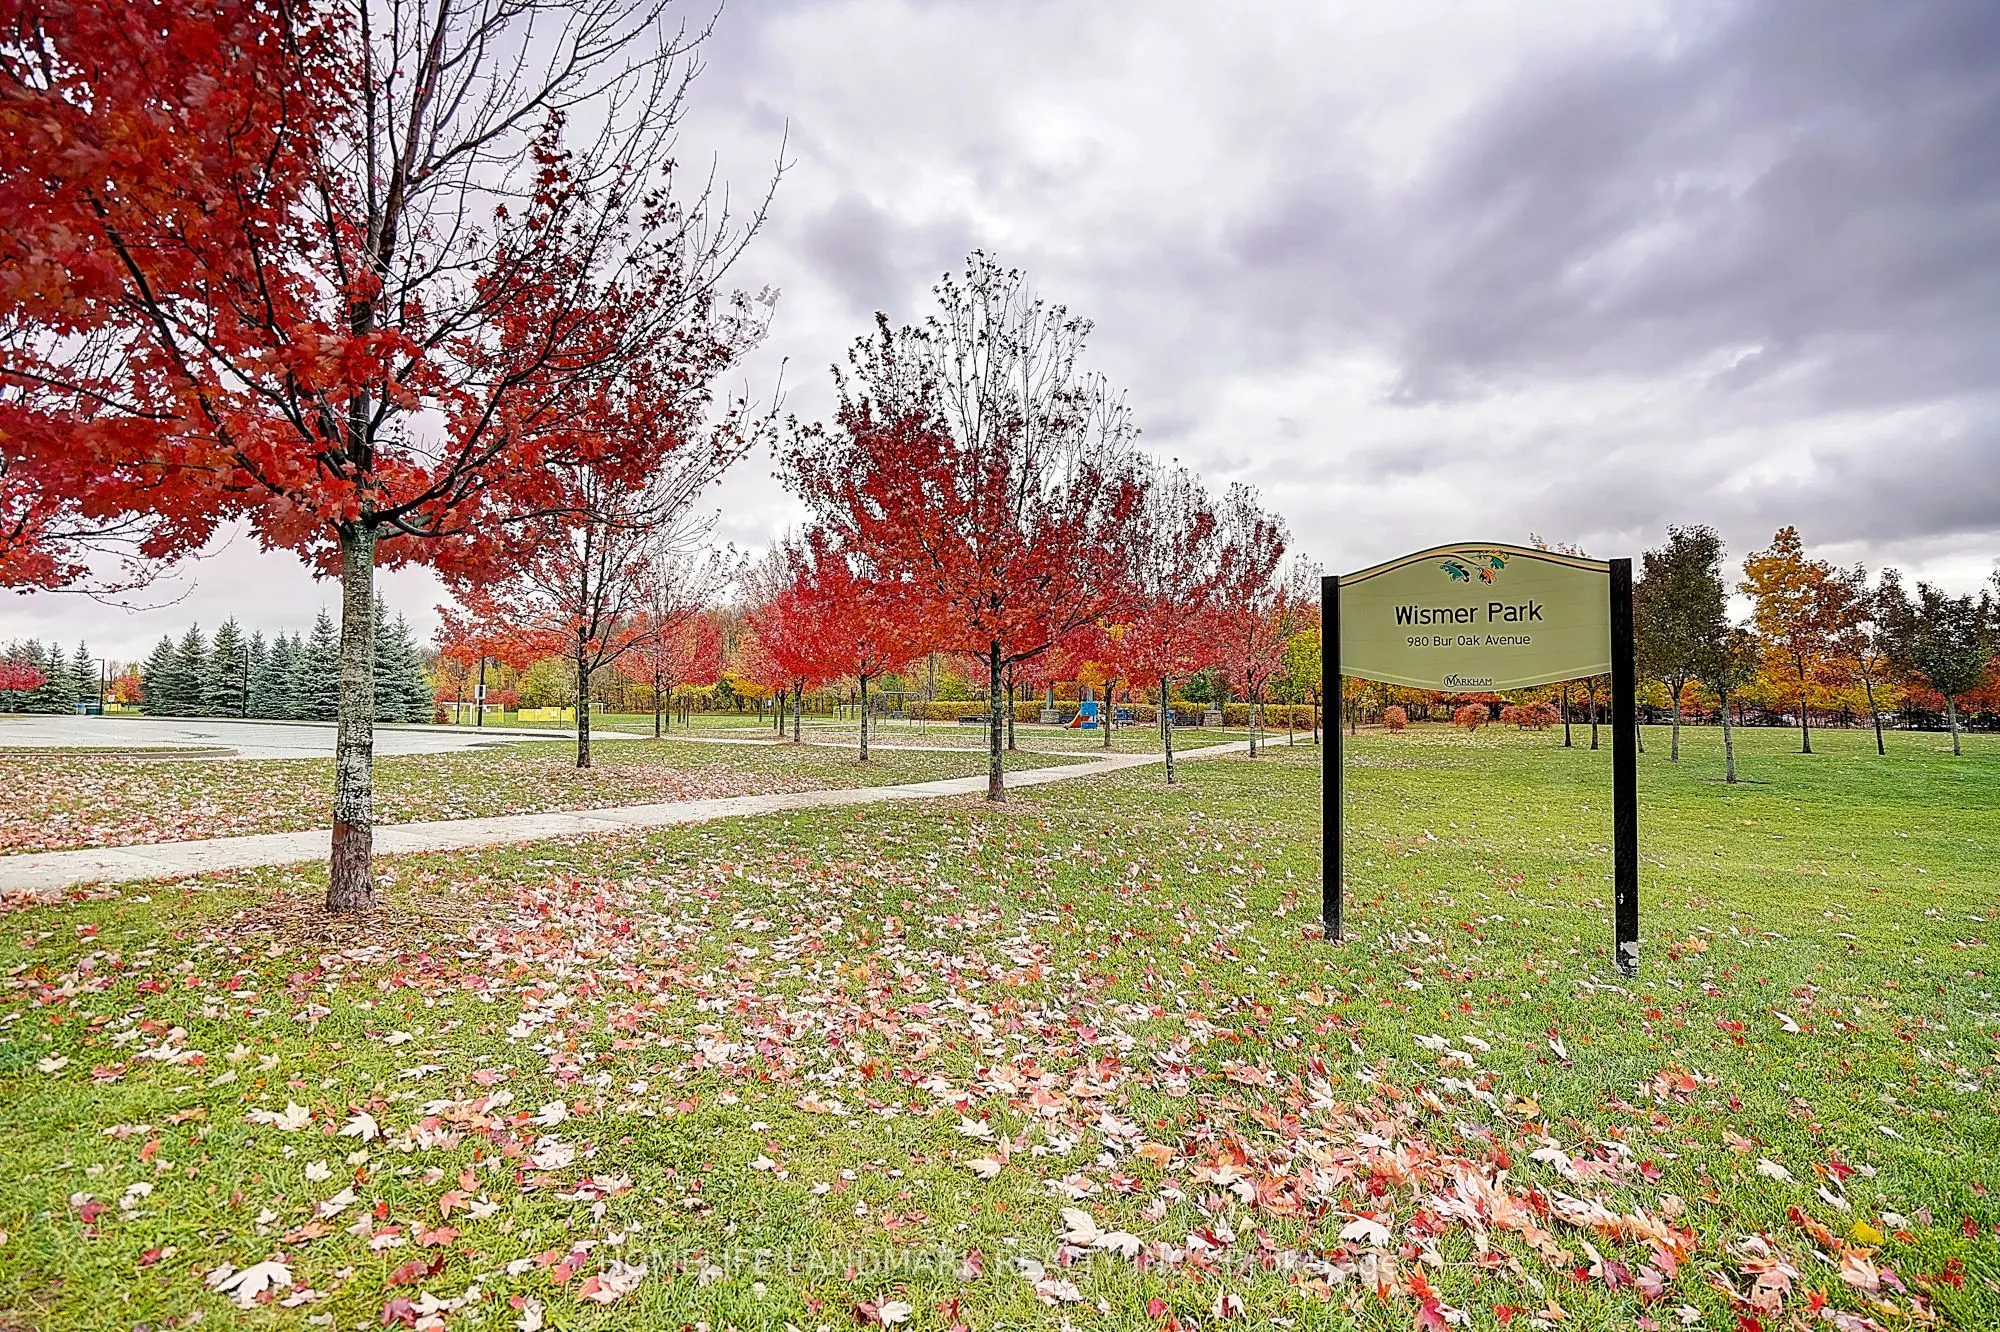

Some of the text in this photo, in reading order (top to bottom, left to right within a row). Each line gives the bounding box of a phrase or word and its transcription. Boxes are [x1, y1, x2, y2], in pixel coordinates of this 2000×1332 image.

[1395, 600, 1543, 625] Wismer Park
[1407, 635, 1531, 647] 980 Bur Oak Avenue
[1443, 674, 1492, 687] MARKHAM
